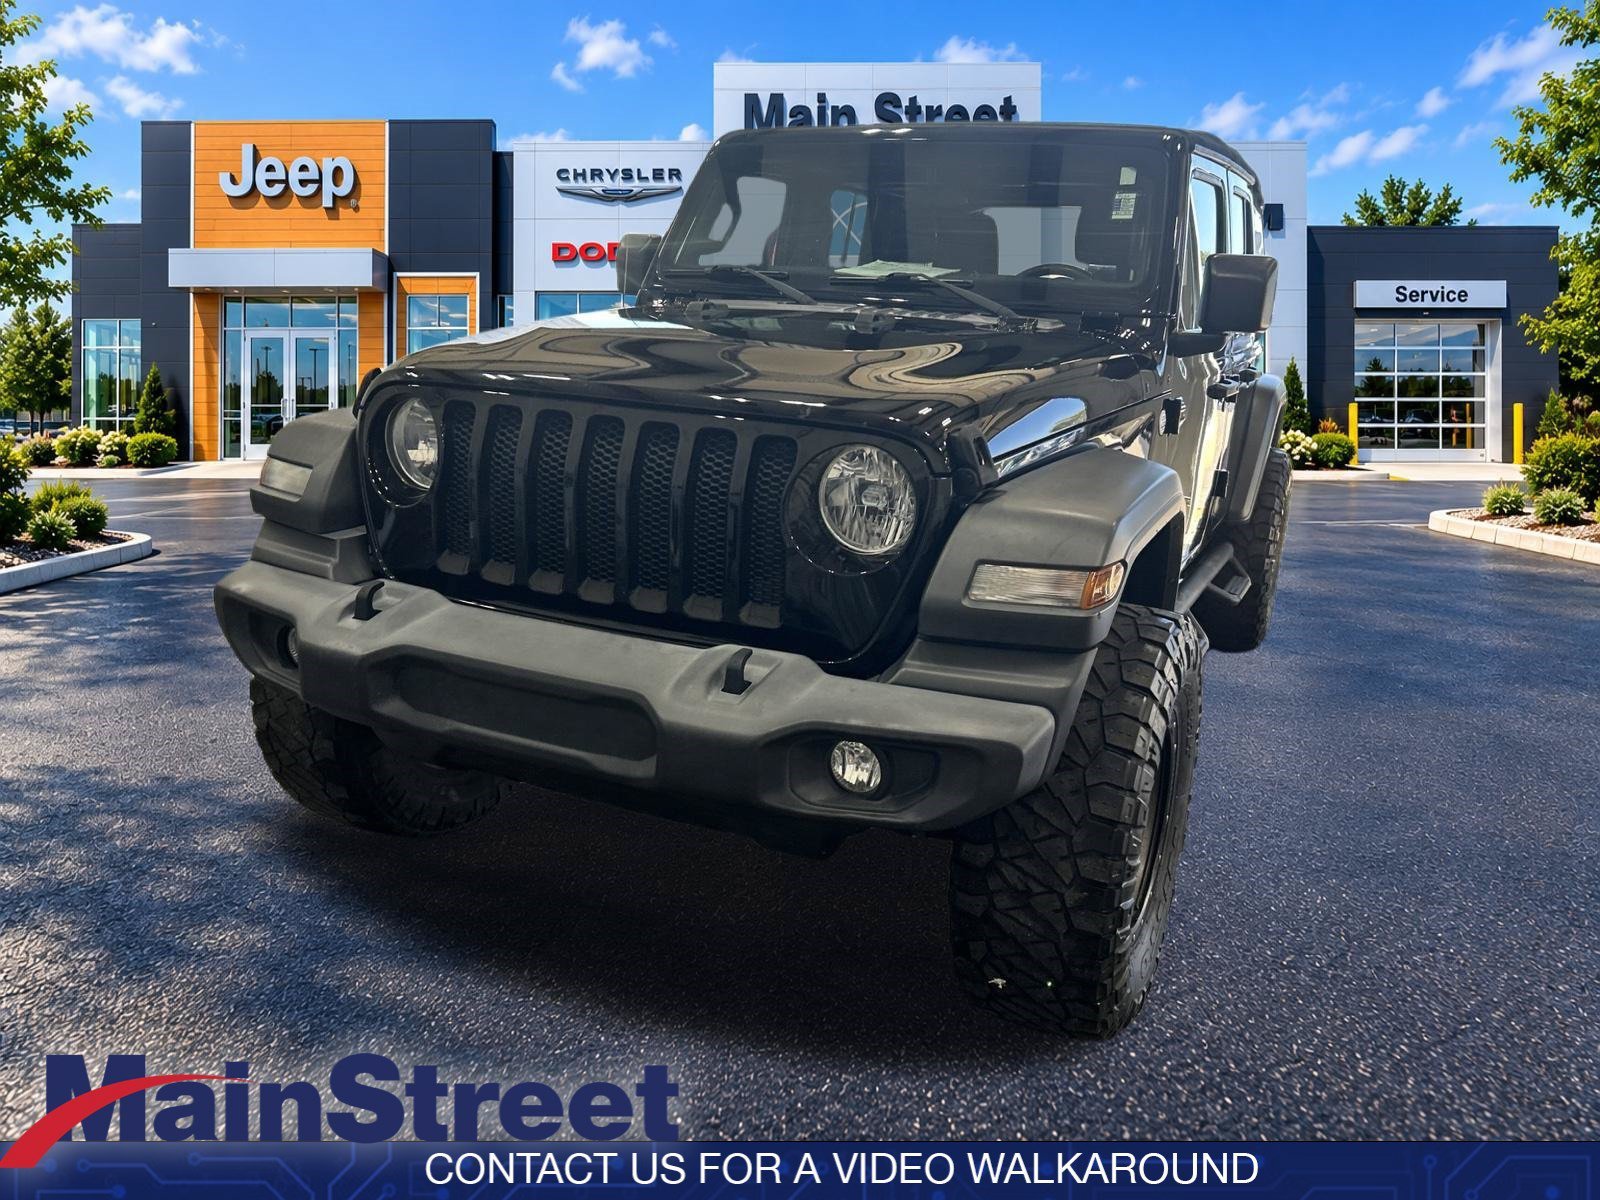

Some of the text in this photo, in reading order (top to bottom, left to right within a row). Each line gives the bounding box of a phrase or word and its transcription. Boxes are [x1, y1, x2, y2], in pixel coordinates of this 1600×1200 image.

[744, 91, 1017, 130] Main Street
[219, 143, 354, 208] Jeep
[556, 168, 682, 182] CHRYSLER
[1395, 285, 1469, 303] Service
